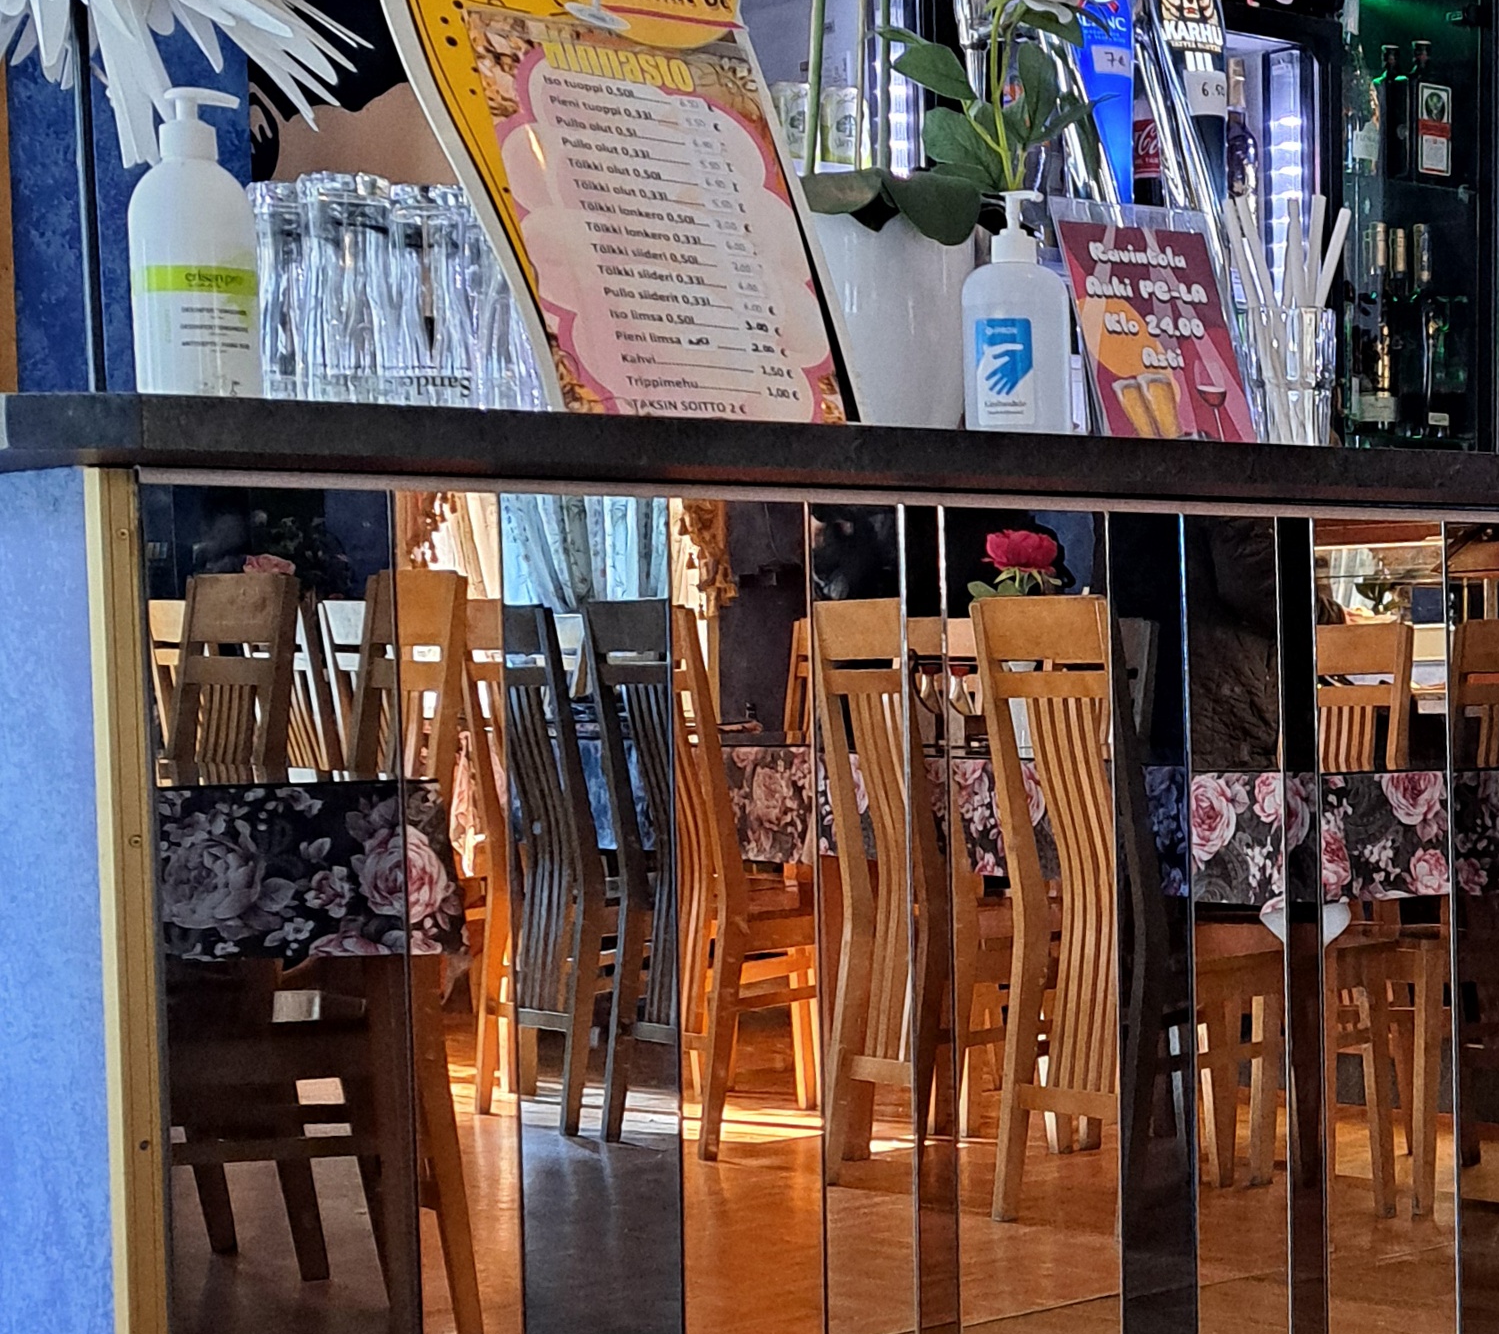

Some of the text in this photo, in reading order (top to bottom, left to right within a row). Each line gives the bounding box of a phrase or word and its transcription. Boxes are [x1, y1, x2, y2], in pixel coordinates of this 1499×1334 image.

[1163, 19, 1224, 46] KARHU
[543, 75, 562, 86] Iso
[564, 79, 604, 93] tuoppi
[549, 95, 580, 108] Pieni
[582, 101, 622, 116] tuoppi
[555, 116, 586, 129] Pullo
[589, 122, 614, 134] olut
[561, 136, 592, 150] Pullo
[595, 143, 619, 155] olut
[568, 157, 604, 172] Tölkki
[606, 165, 631, 176] olut
[573, 178, 610, 193] Tölkki
[613, 186, 637, 197] olut
[579, 200, 616, 214] Tölkki
[618, 206, 664, 221] lonkero
[585, 221, 622, 234] Tölkki
[624, 226, 671, 242] lonkero
[590, 242, 628, 256] Tölkki
[631, 249, 668, 261] siideri
[1088, 241, 1187, 269] Ravintola
[597, 264, 635, 277] Tölkki
[637, 269, 674, 283] siideri
[603, 286, 635, 298] Pullo
[638, 290, 680, 304] siiderit
[1085, 275, 1134, 299] Auki
[609, 308, 628, 320] Iso
[630, 309, 664, 322] limsa
[1104, 311, 1204, 338] Klo 24.00
[615, 330, 647, 343] Pieni
[649, 332, 682, 345] limsa
[620, 352, 657, 364] Kahvi
[1141, 346, 1185, 369] Asti
[626, 375, 699, 388] Trippimehu
[632, 399, 677, 412] TAKSIN
[681, 400, 726, 412] SOITTO
